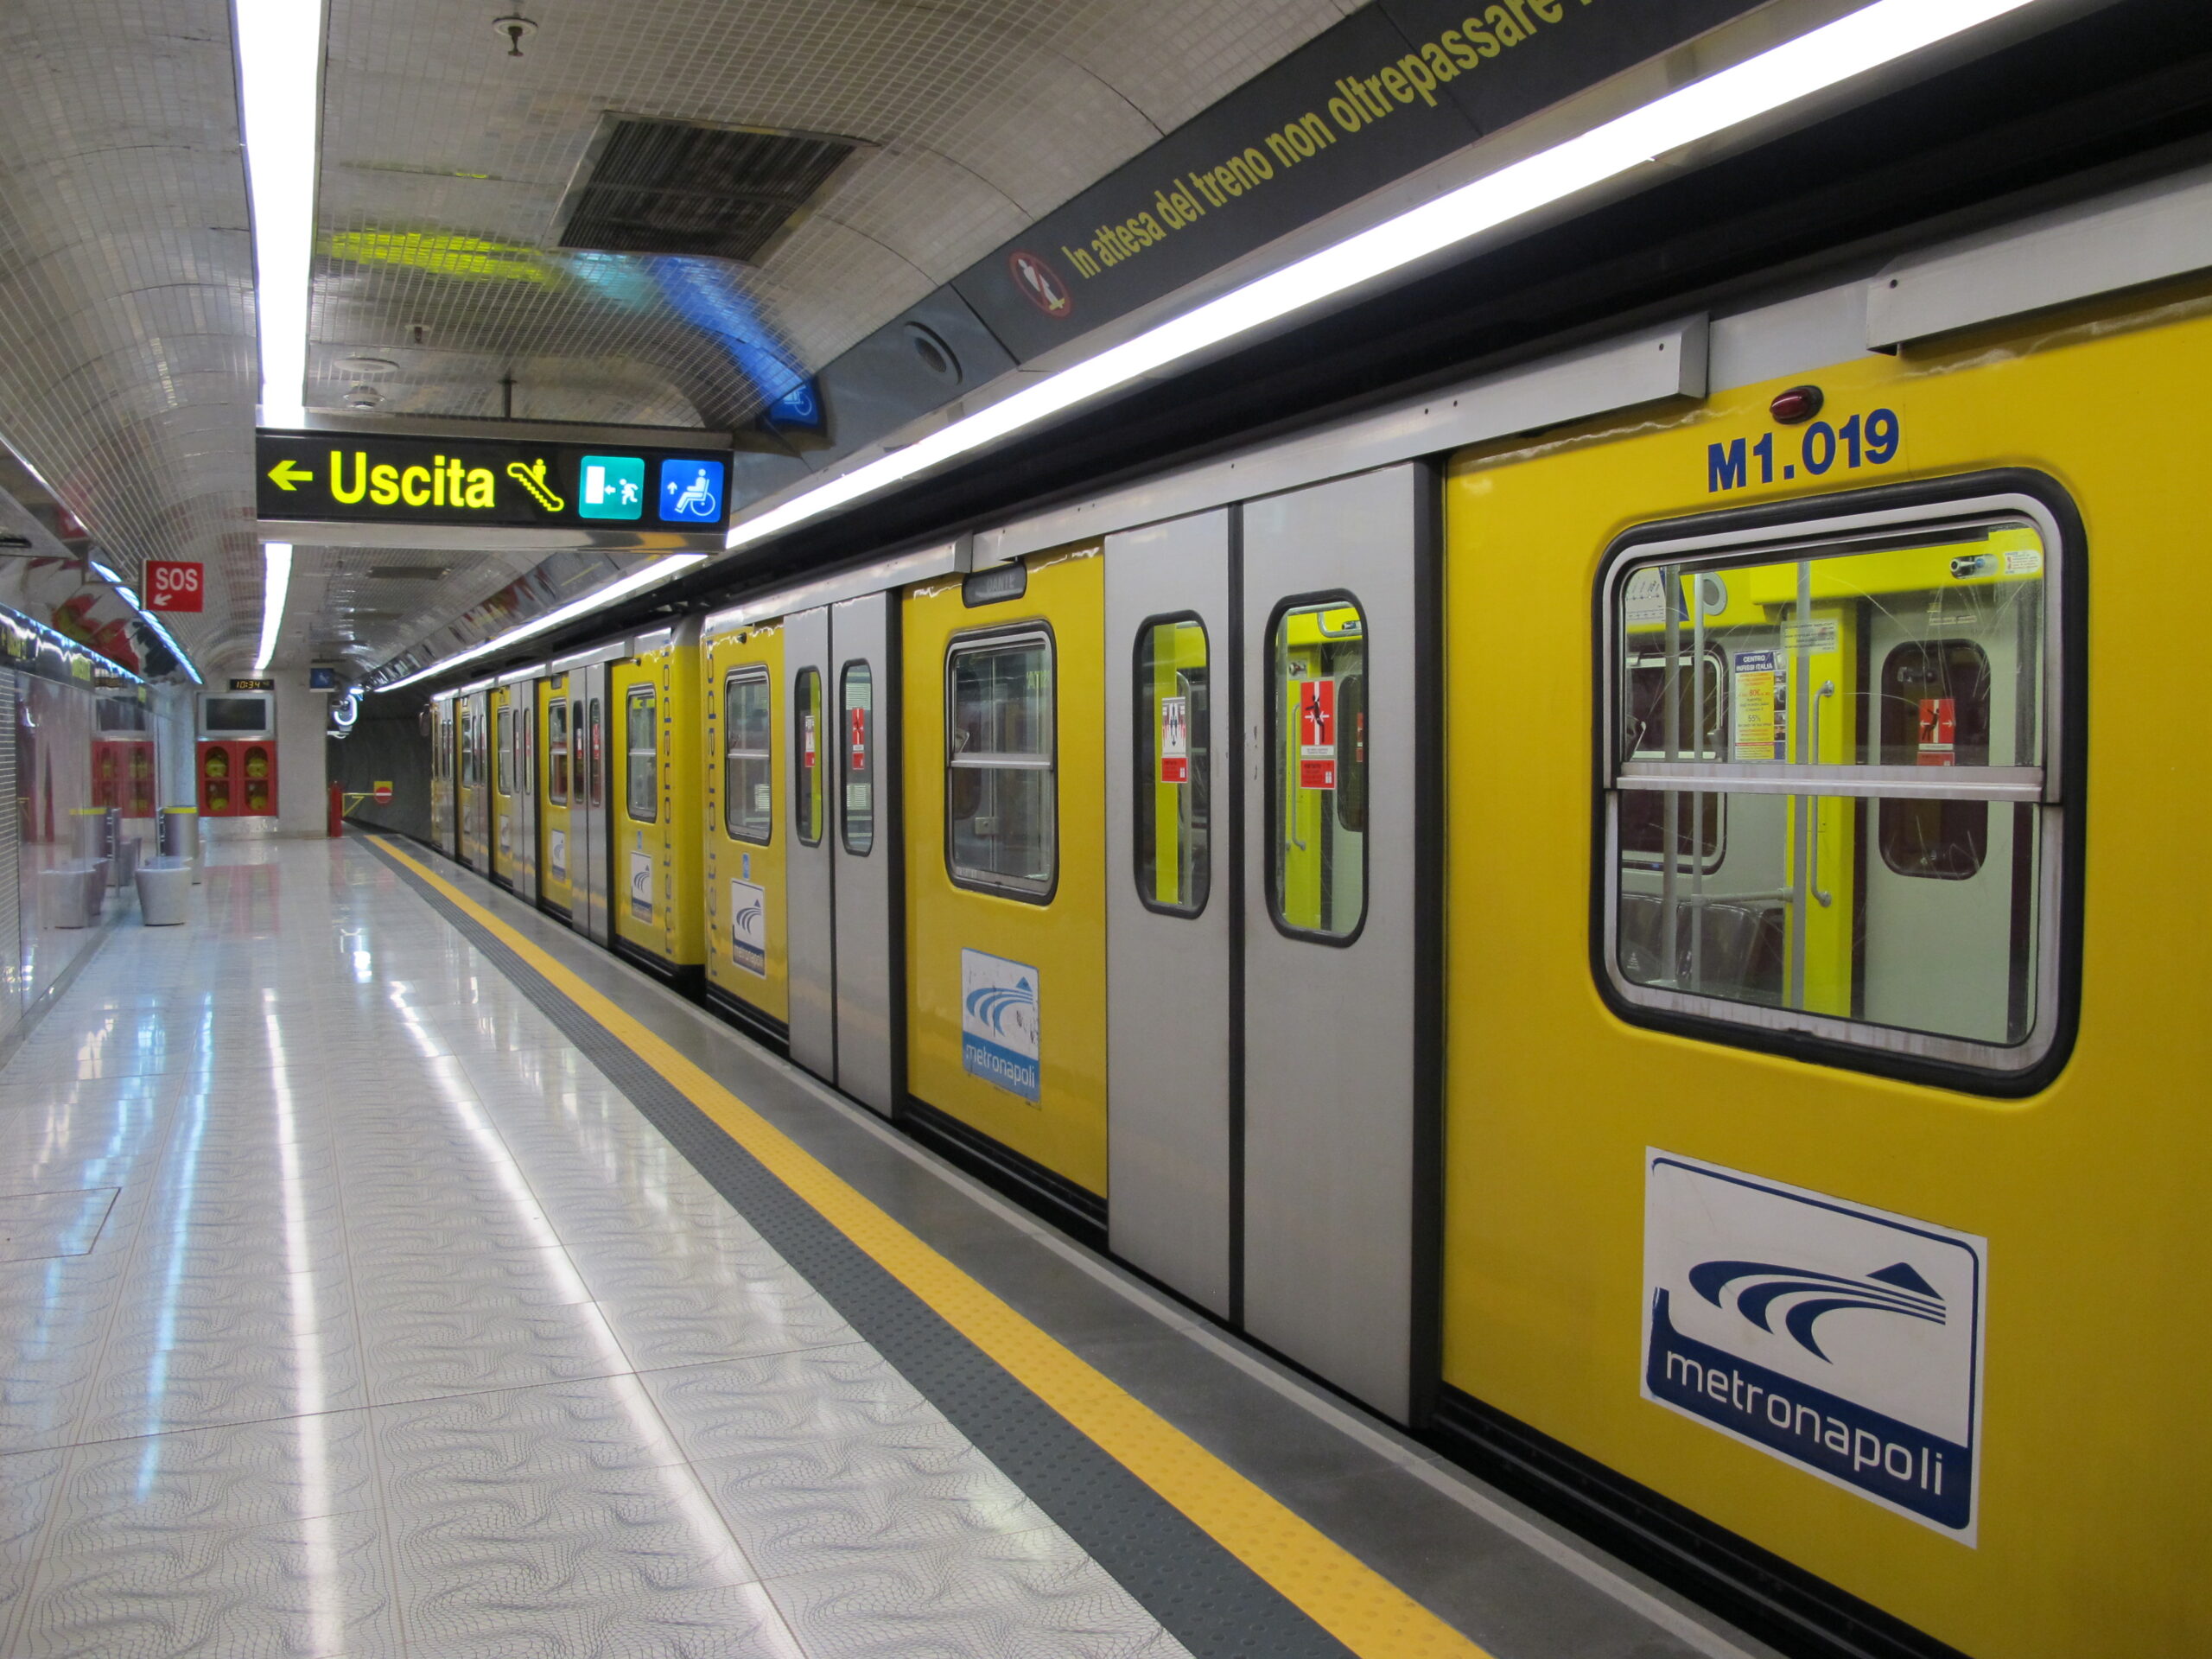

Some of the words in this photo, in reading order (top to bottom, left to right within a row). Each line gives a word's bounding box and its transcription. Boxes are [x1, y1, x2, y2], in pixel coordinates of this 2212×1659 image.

[1061, 245, 1102, 279] In
[1091, 211, 1167, 267] attesa
[1154, 178, 1206, 230] del
[1188, 147, 1274, 207] treno
[1264, 111, 1337, 168] non
[1328, 0, 1564, 133] oltrepassare
[1707, 408, 1899, 493] M1.019
[329, 450, 496, 509] Uscita
[156, 567, 199, 592] SOS
[236, 680, 260, 689] 10:34
[1743, 654, 1765, 663] CENTRO
[966, 1043, 1035, 1088] metronapoli
[1666, 1350, 1942, 1495] metronapoli
